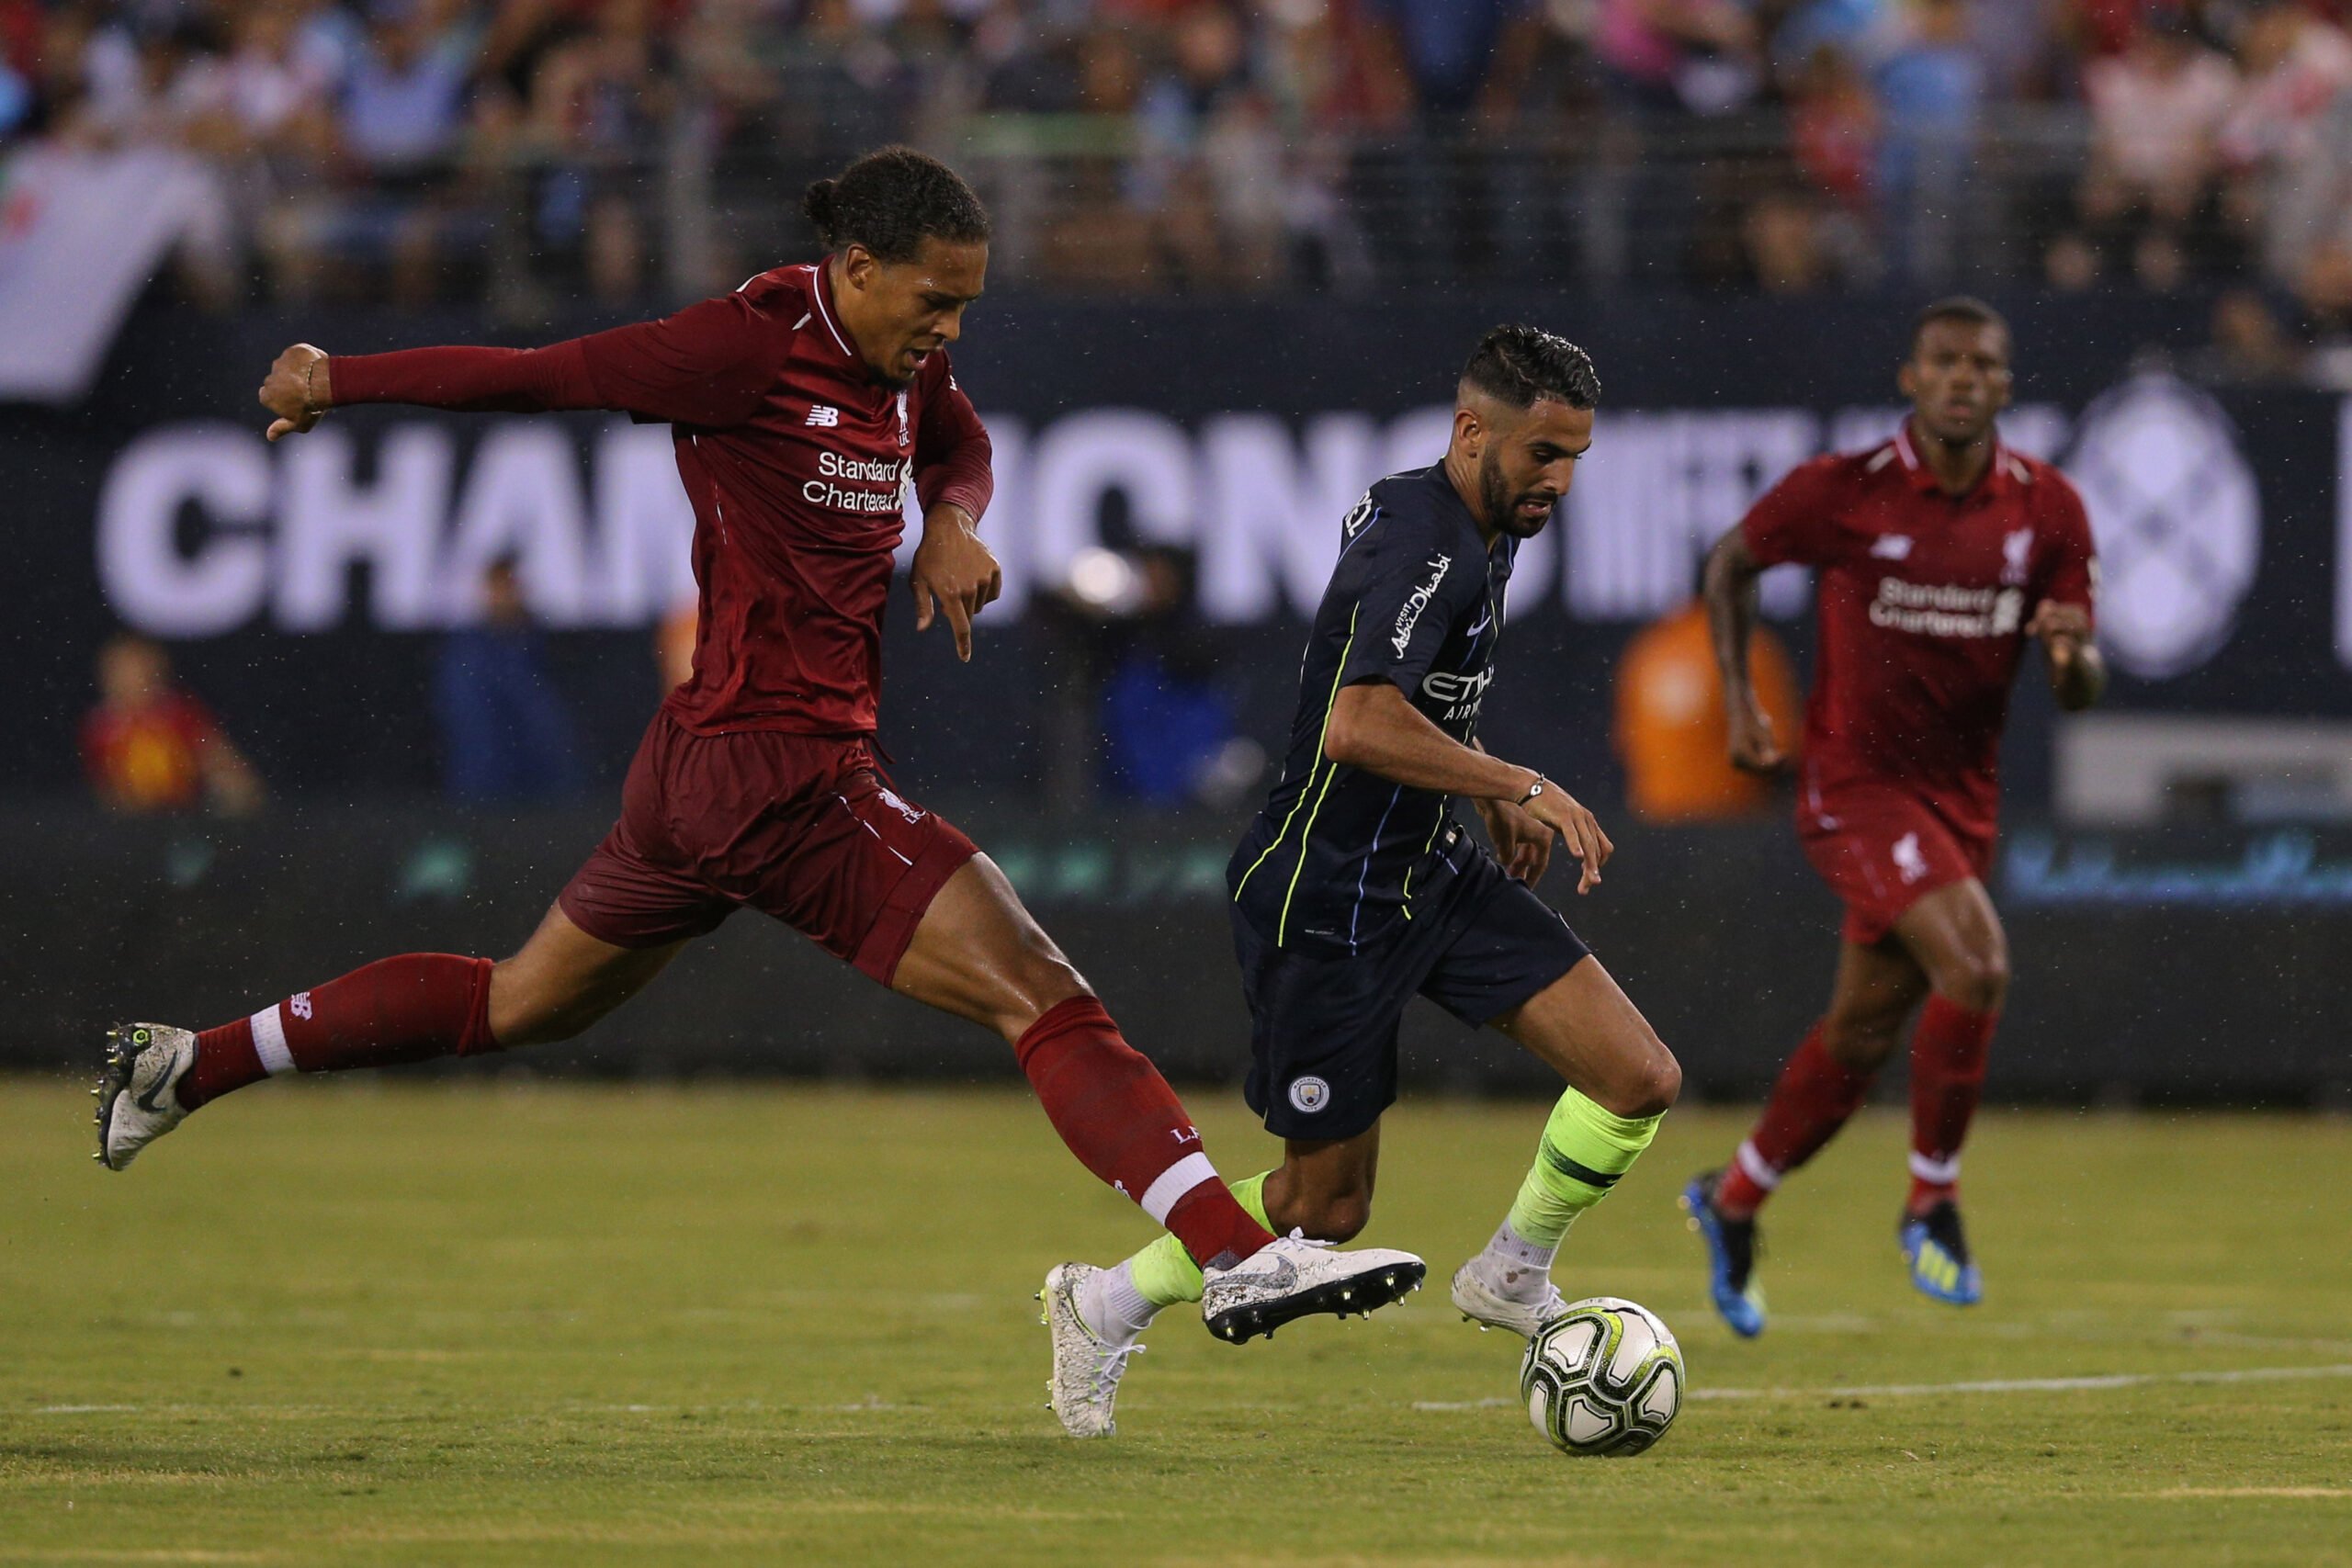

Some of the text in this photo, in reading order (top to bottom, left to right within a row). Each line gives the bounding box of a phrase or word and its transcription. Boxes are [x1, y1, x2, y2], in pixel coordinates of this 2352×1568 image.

[818, 451, 900, 482] Standard
[802, 480, 897, 512] Chartered
[1395, 602, 1412, 626] VISIT
[1422, 663, 1495, 703] ETIH
